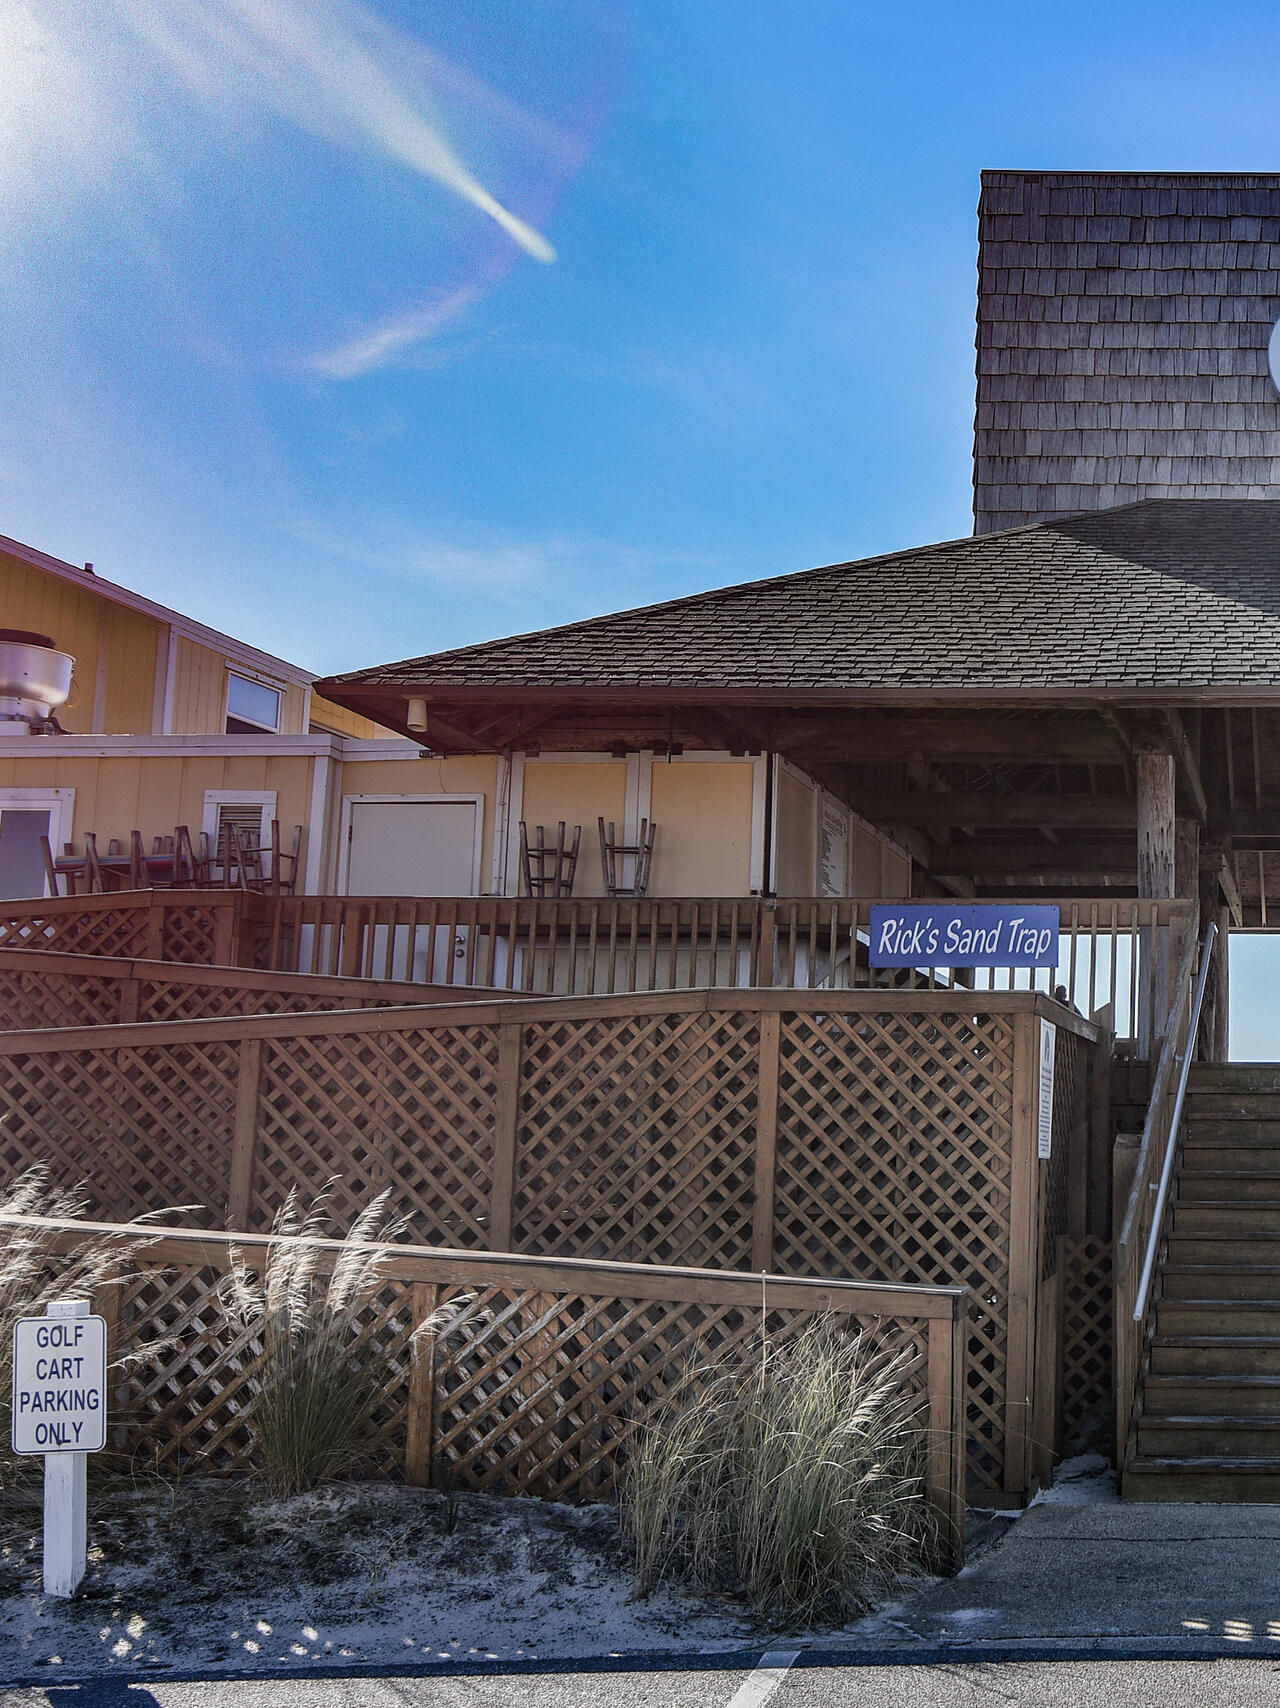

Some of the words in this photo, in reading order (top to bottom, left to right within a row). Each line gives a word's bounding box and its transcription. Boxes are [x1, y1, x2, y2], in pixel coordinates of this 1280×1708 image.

[879, 917, 940, 955] Rick's
[944, 918, 1003, 955] Sand
[1008, 917, 1052, 960] Trap
[36, 1325, 84, 1348] GOLF
[36, 1357, 84, 1380] CART
[20, 1388, 99, 1413] PARKING
[35, 1421, 84, 1445] ONLY
